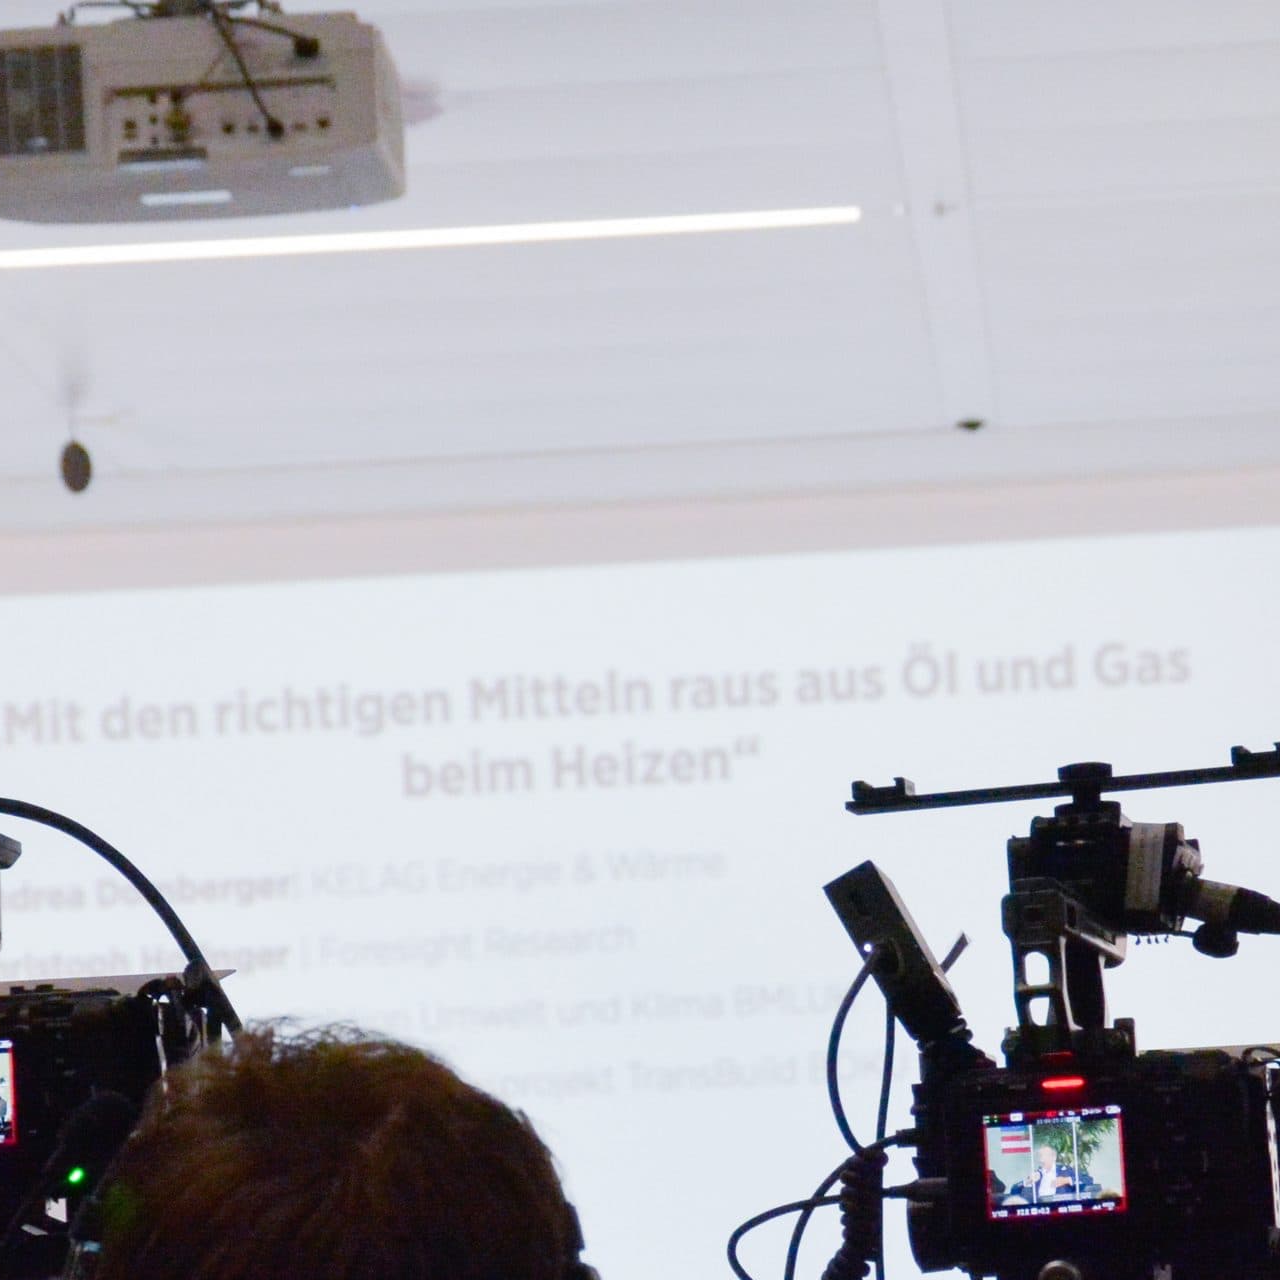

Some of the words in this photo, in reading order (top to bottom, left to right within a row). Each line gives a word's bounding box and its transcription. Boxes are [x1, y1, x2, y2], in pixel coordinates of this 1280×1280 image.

[100, 690, 198, 742] den
[213, 681, 450, 737] richtigen
[469, 669, 652, 721] Mitteln
[669, 670, 779, 713] raus
[795, 664, 885, 706] aus
[901, 641, 958, 698] Öl
[975, 645, 1076, 695] und
[1093, 641, 1193, 688] Gas
[402, 749, 533, 799] beim
[4, 880, 86, 912] drea
[311, 858, 429, 897] KELAG
[435, 855, 563, 895] Energie
[571, 849, 597, 887] &
[603, 846, 728, 882] Wärme
[318, 931, 473, 967] Foresight
[483, 924, 639, 960] Research
[419, 996, 546, 1032] Umwelt
[557, 995, 621, 1027] und
[631, 987, 725, 1022] Klima
